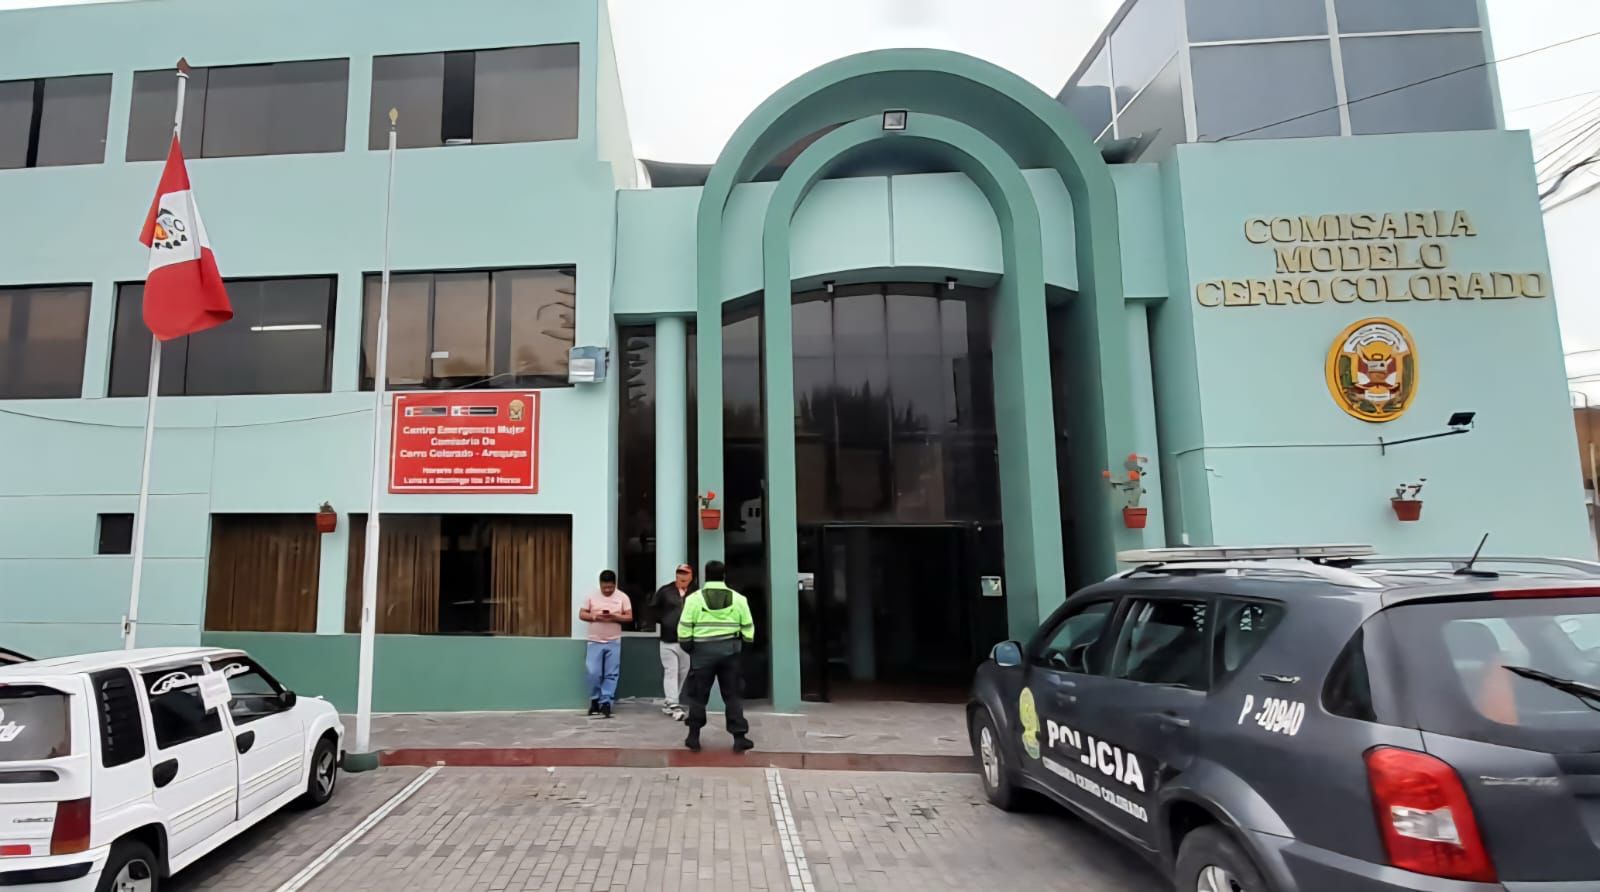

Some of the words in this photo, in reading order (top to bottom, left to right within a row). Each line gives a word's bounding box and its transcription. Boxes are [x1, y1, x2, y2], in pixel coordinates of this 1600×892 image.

[1244, 210, 1477, 244] COMISARIA
[1274, 243, 1448, 274] MODELO
[1196, 277, 1325, 307] CERRO
[1331, 271, 1548, 303] COLORADO
[497, 424, 525, 435] Mujer
[429, 449, 474, 458] Colorado
[481, 448, 528, 459] Arequipa
[1046, 719, 1146, 793] POLICIA
